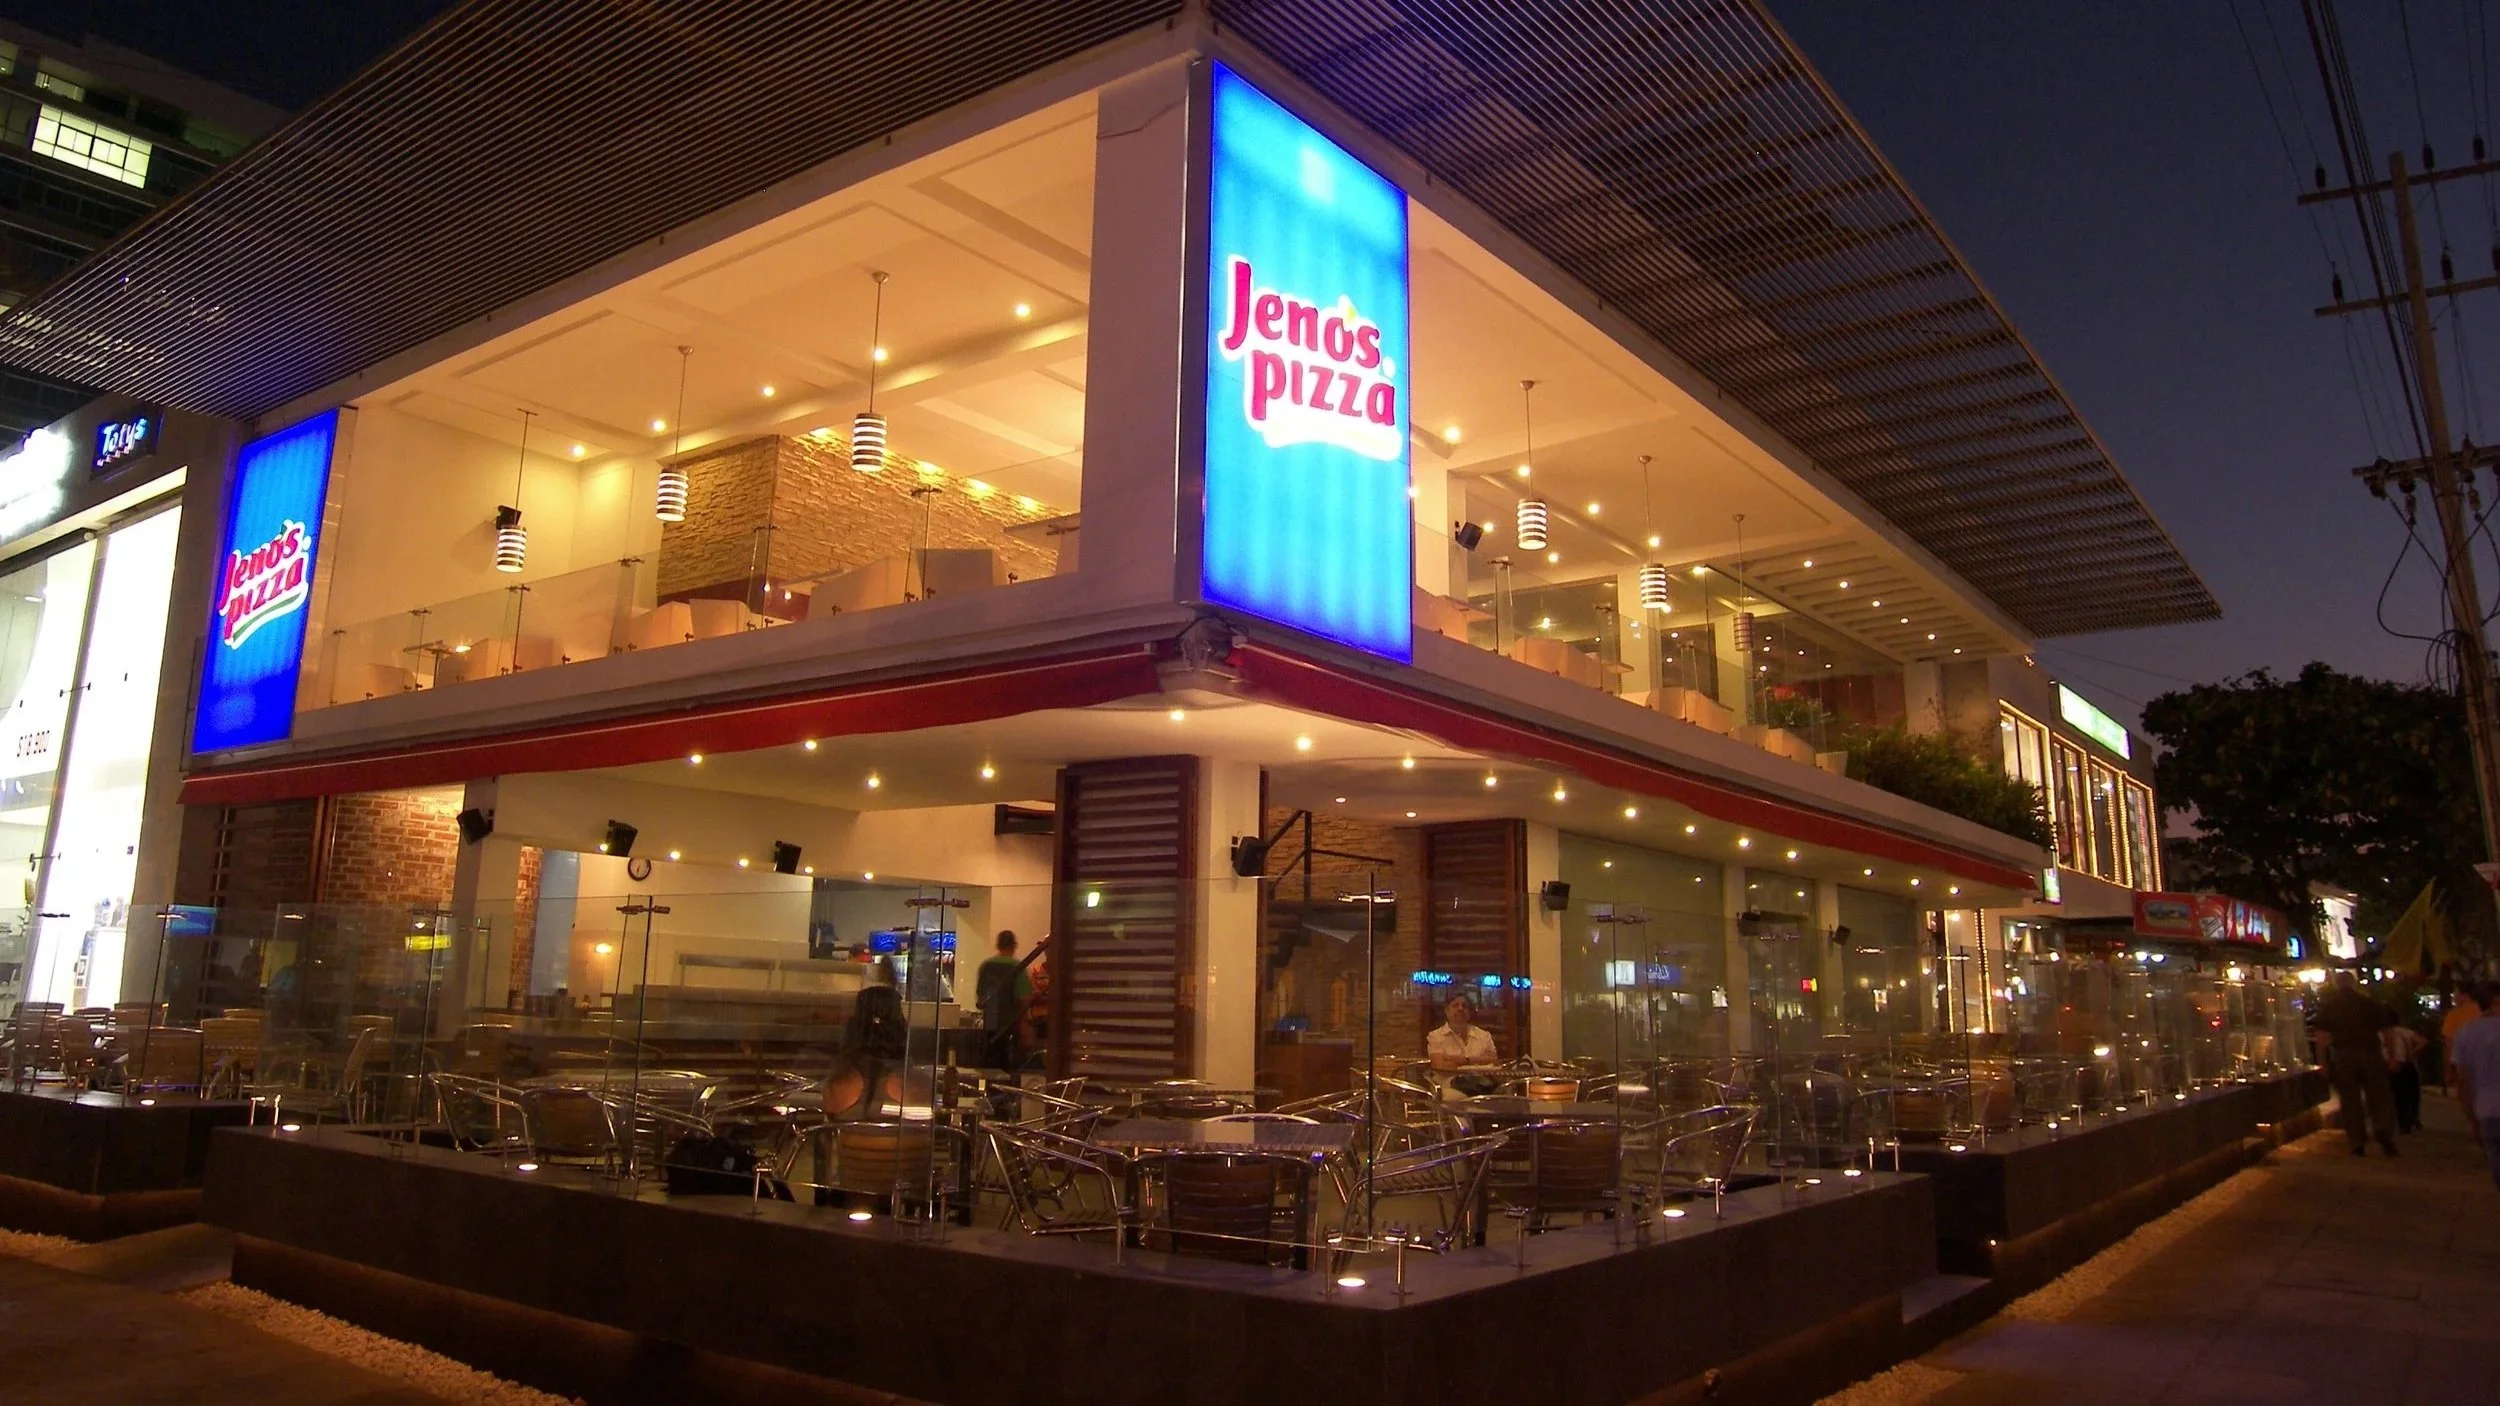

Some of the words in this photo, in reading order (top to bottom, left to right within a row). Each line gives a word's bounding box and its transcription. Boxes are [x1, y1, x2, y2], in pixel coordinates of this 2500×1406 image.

[1224, 260, 1381, 369] Jeno's
[1251, 349, 1397, 426] pizza
[217, 523, 301, 611] Jeno's
[223, 557, 304, 640] pizza
